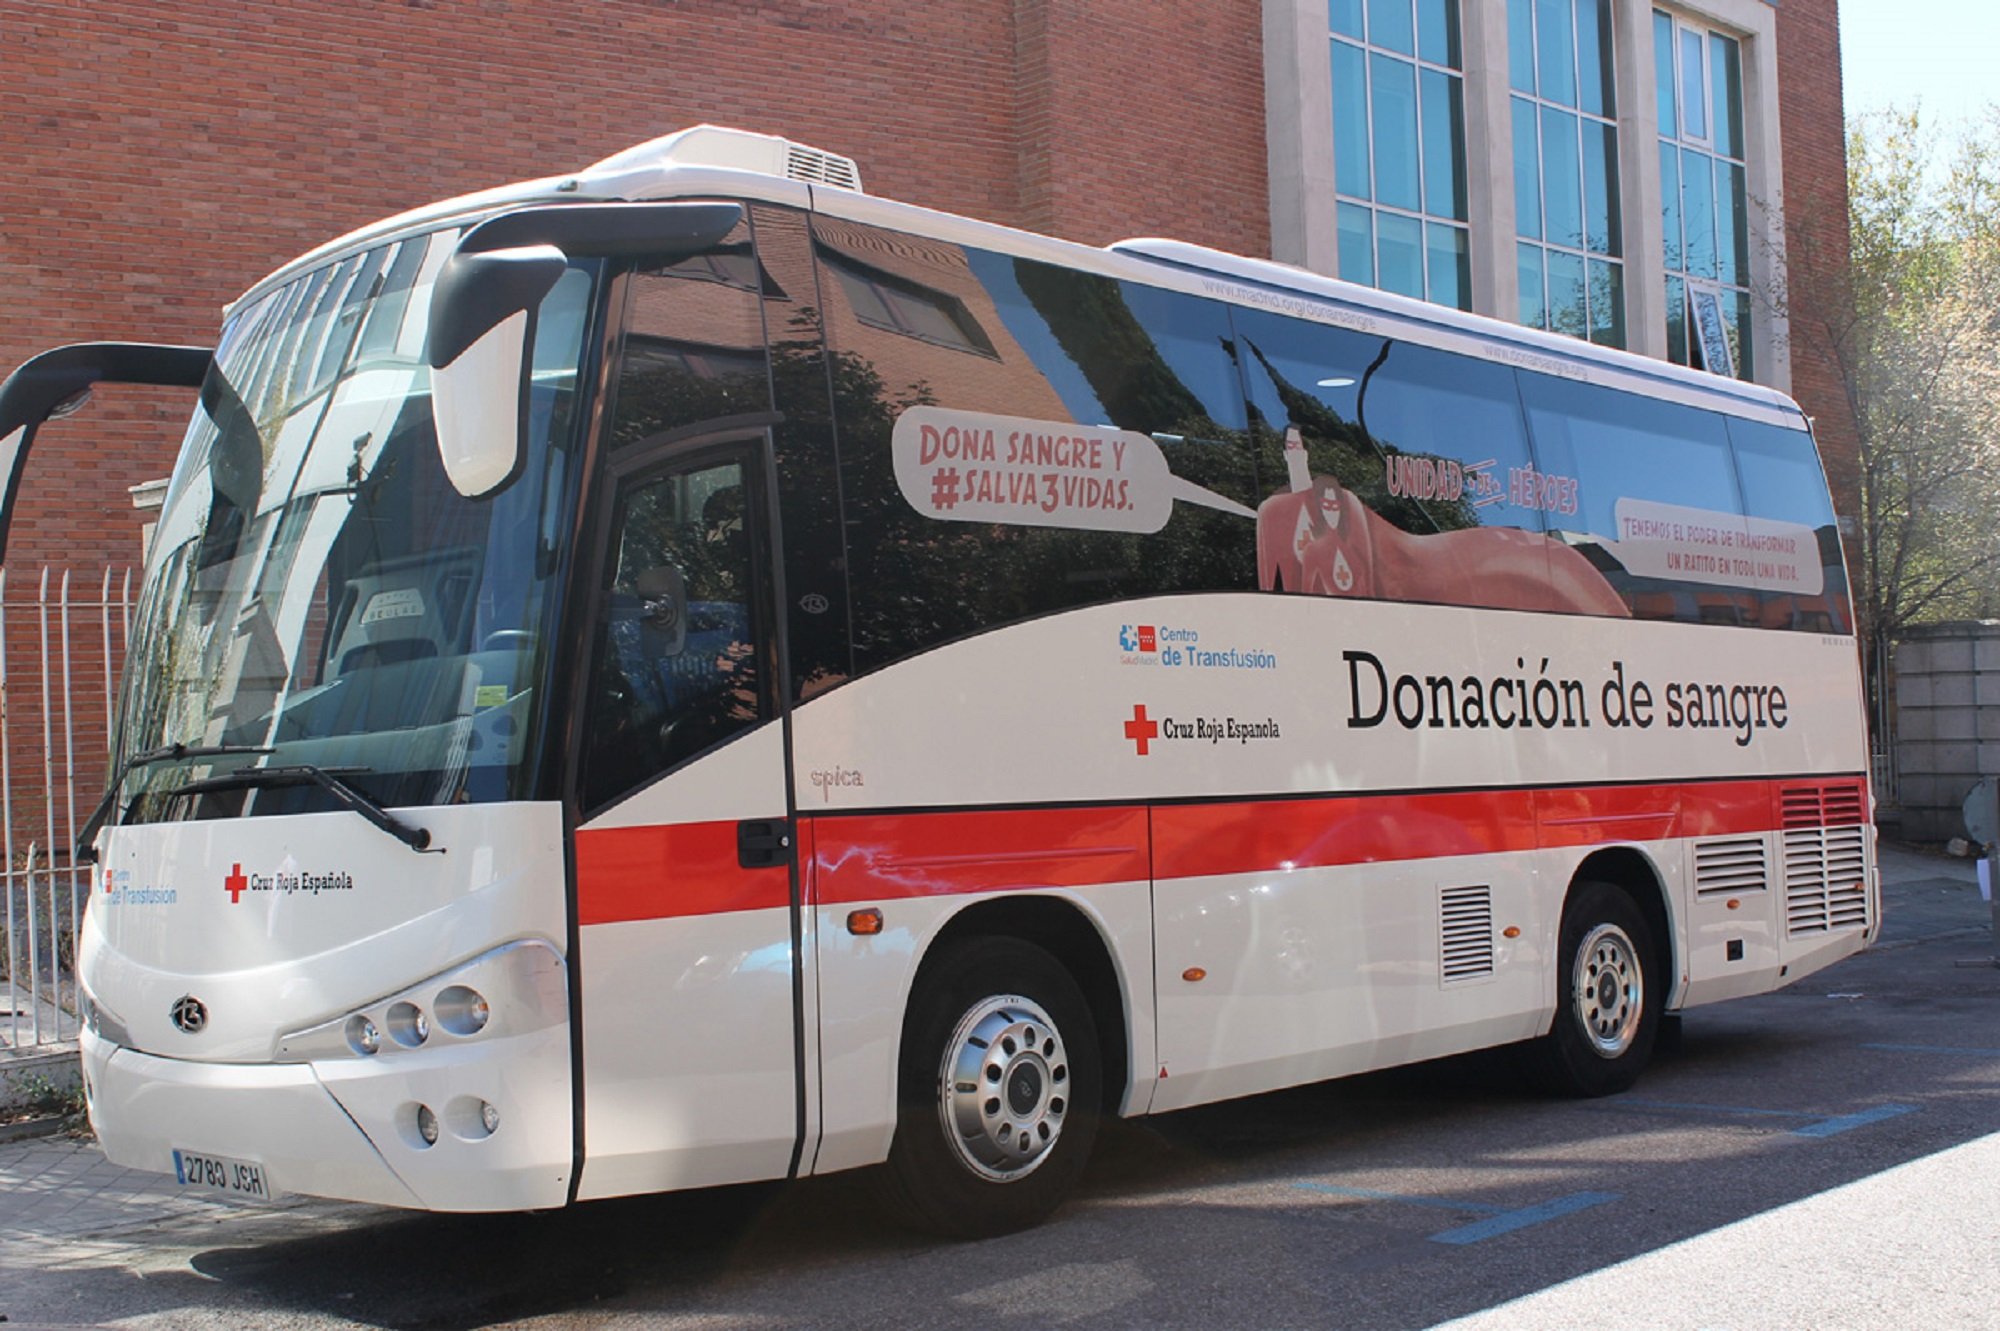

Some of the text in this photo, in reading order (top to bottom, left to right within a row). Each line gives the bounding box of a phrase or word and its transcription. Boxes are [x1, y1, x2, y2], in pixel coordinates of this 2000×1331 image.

[920, 424, 1126, 471] DONA SANGRE Y
[931, 467, 1135, 513] #SALVA3VIDAS.
[1387, 455, 1578, 516] UNIDAD DE HÉROES
[1624, 517, 1796, 554] TENEMOS EL PODER DE TRANSFORMAR
[1667, 552, 1681, 570] UN
[1684, 553, 1715, 573] RATITO
[1719, 557, 1730, 575] EN
[1733, 560, 1755, 577] TODA
[1758, 562, 1775, 579] UNA
[1160, 626, 1199, 642] Centro
[1162, 646, 1276, 669] de Transfusión
[1342, 650, 1788, 746] Donación de sangre
[1163, 717, 1194, 739] Cruz
[1196, 717, 1225, 744] Roja
[811, 765, 864, 803] spica
[251, 870, 353, 895] Cruz Roja Española
[233, 1163, 263, 1195] JSH
